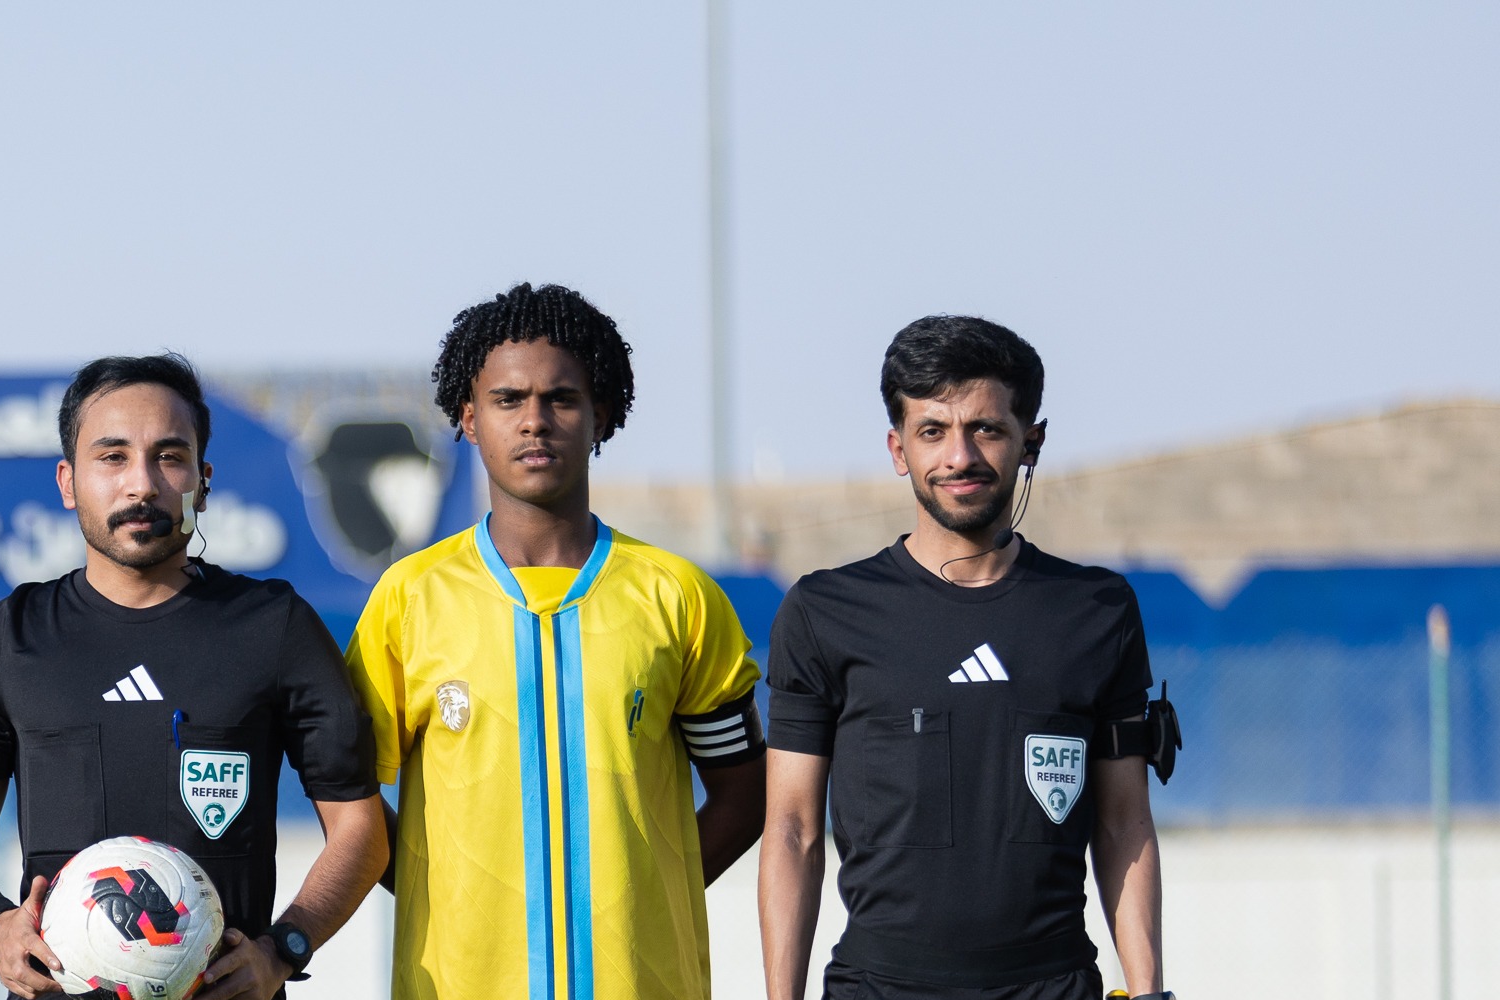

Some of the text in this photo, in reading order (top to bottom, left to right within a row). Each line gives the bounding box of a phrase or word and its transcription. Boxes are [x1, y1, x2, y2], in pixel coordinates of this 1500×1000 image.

[1031, 746, 1081, 769] SAFF
[187, 761, 245, 783] SAFF
[1037, 772, 1076, 784] REFEREE
[192, 787, 238, 798] REFEREE
